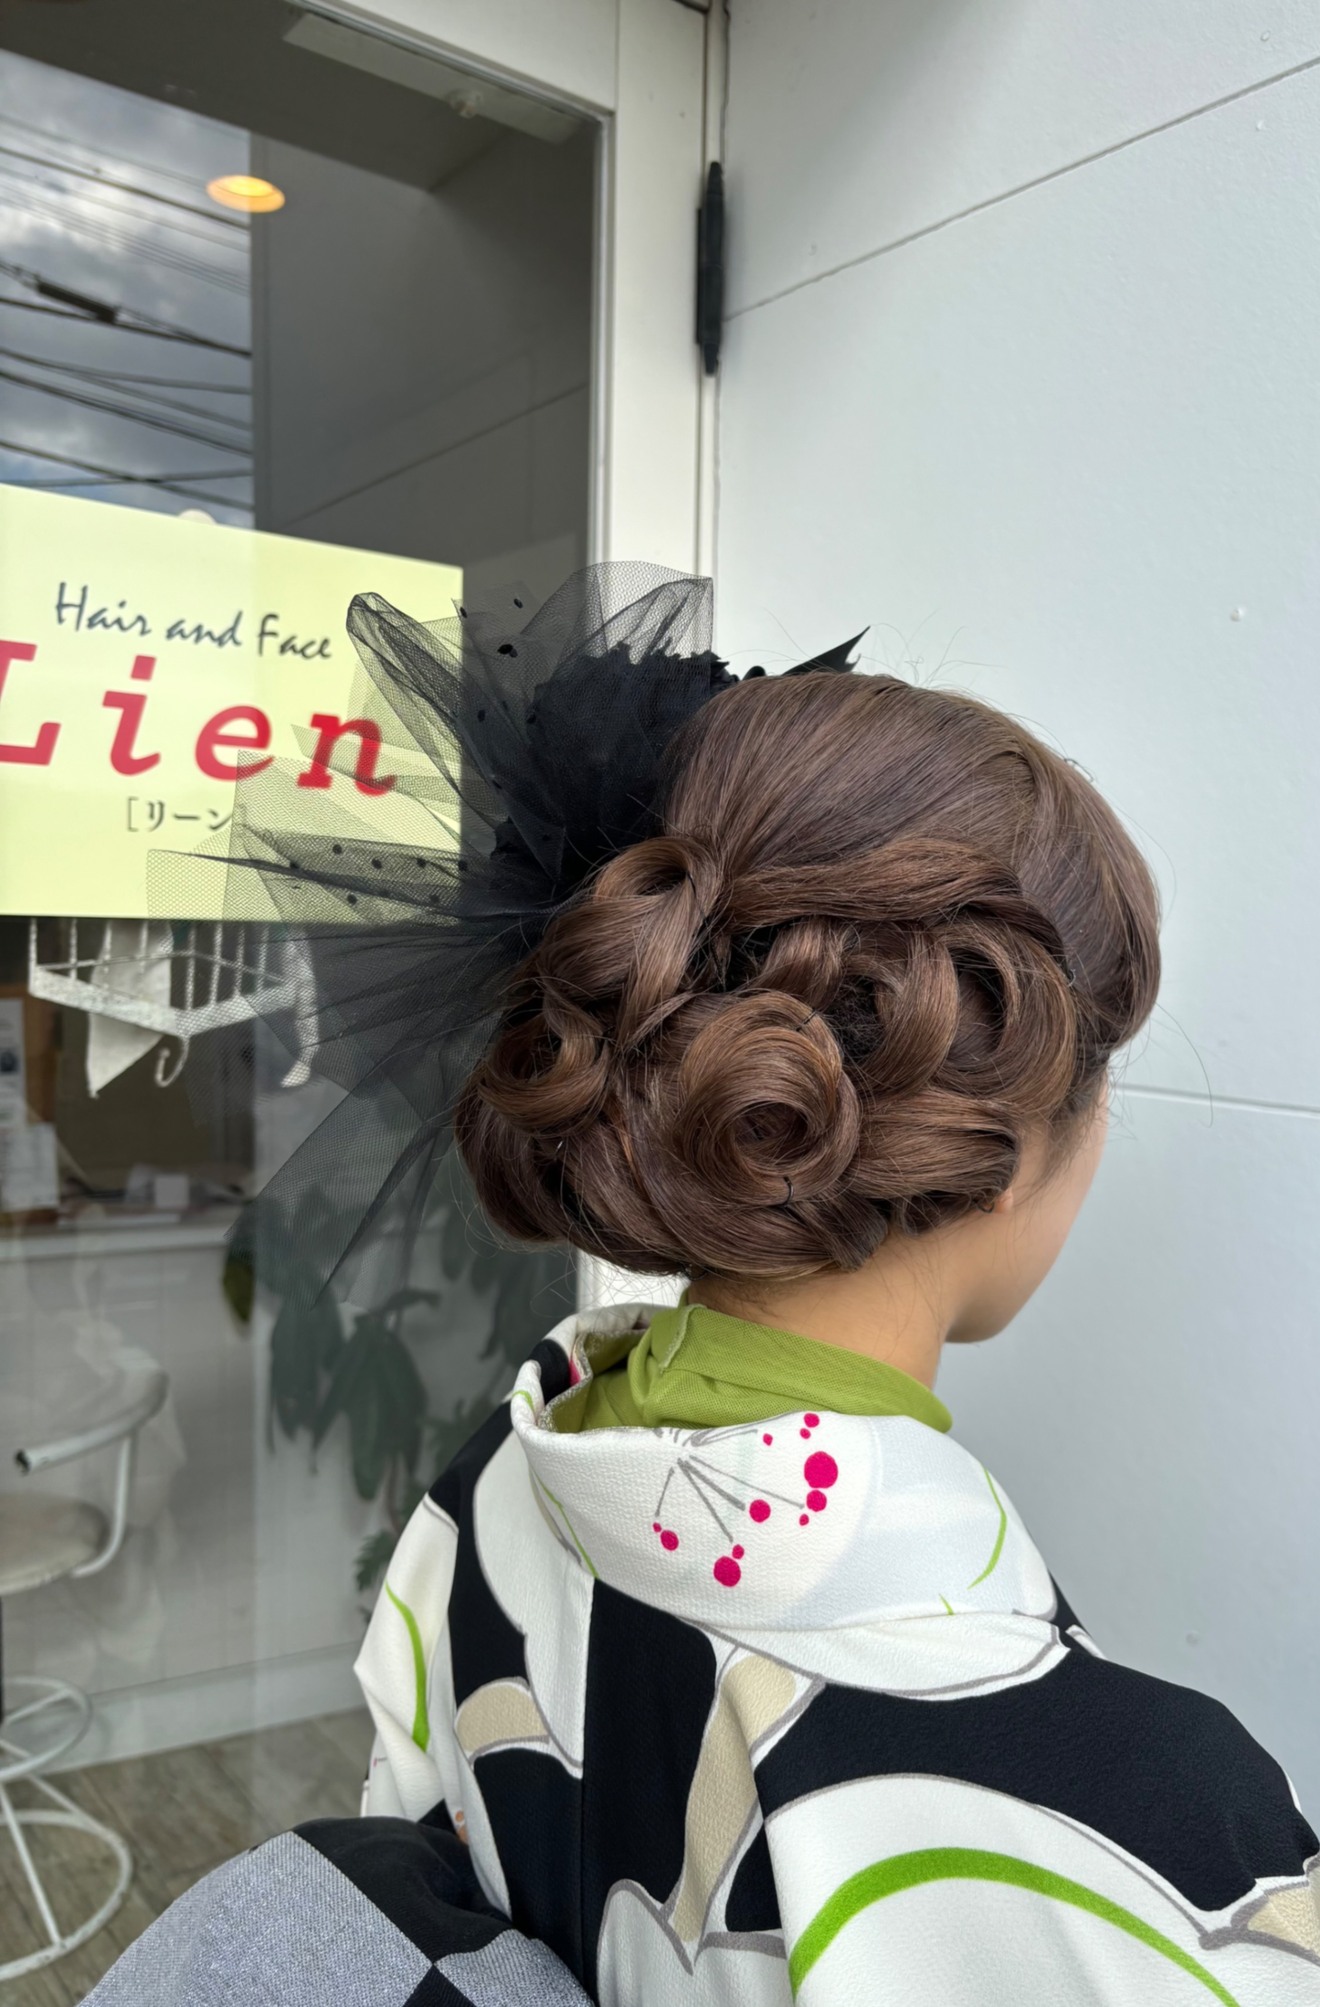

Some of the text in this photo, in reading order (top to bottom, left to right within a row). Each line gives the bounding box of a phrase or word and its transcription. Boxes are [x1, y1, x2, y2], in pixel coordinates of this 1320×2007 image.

[55, 581, 333, 660] Hair and Face
[0, 639, 397, 796] Lien
